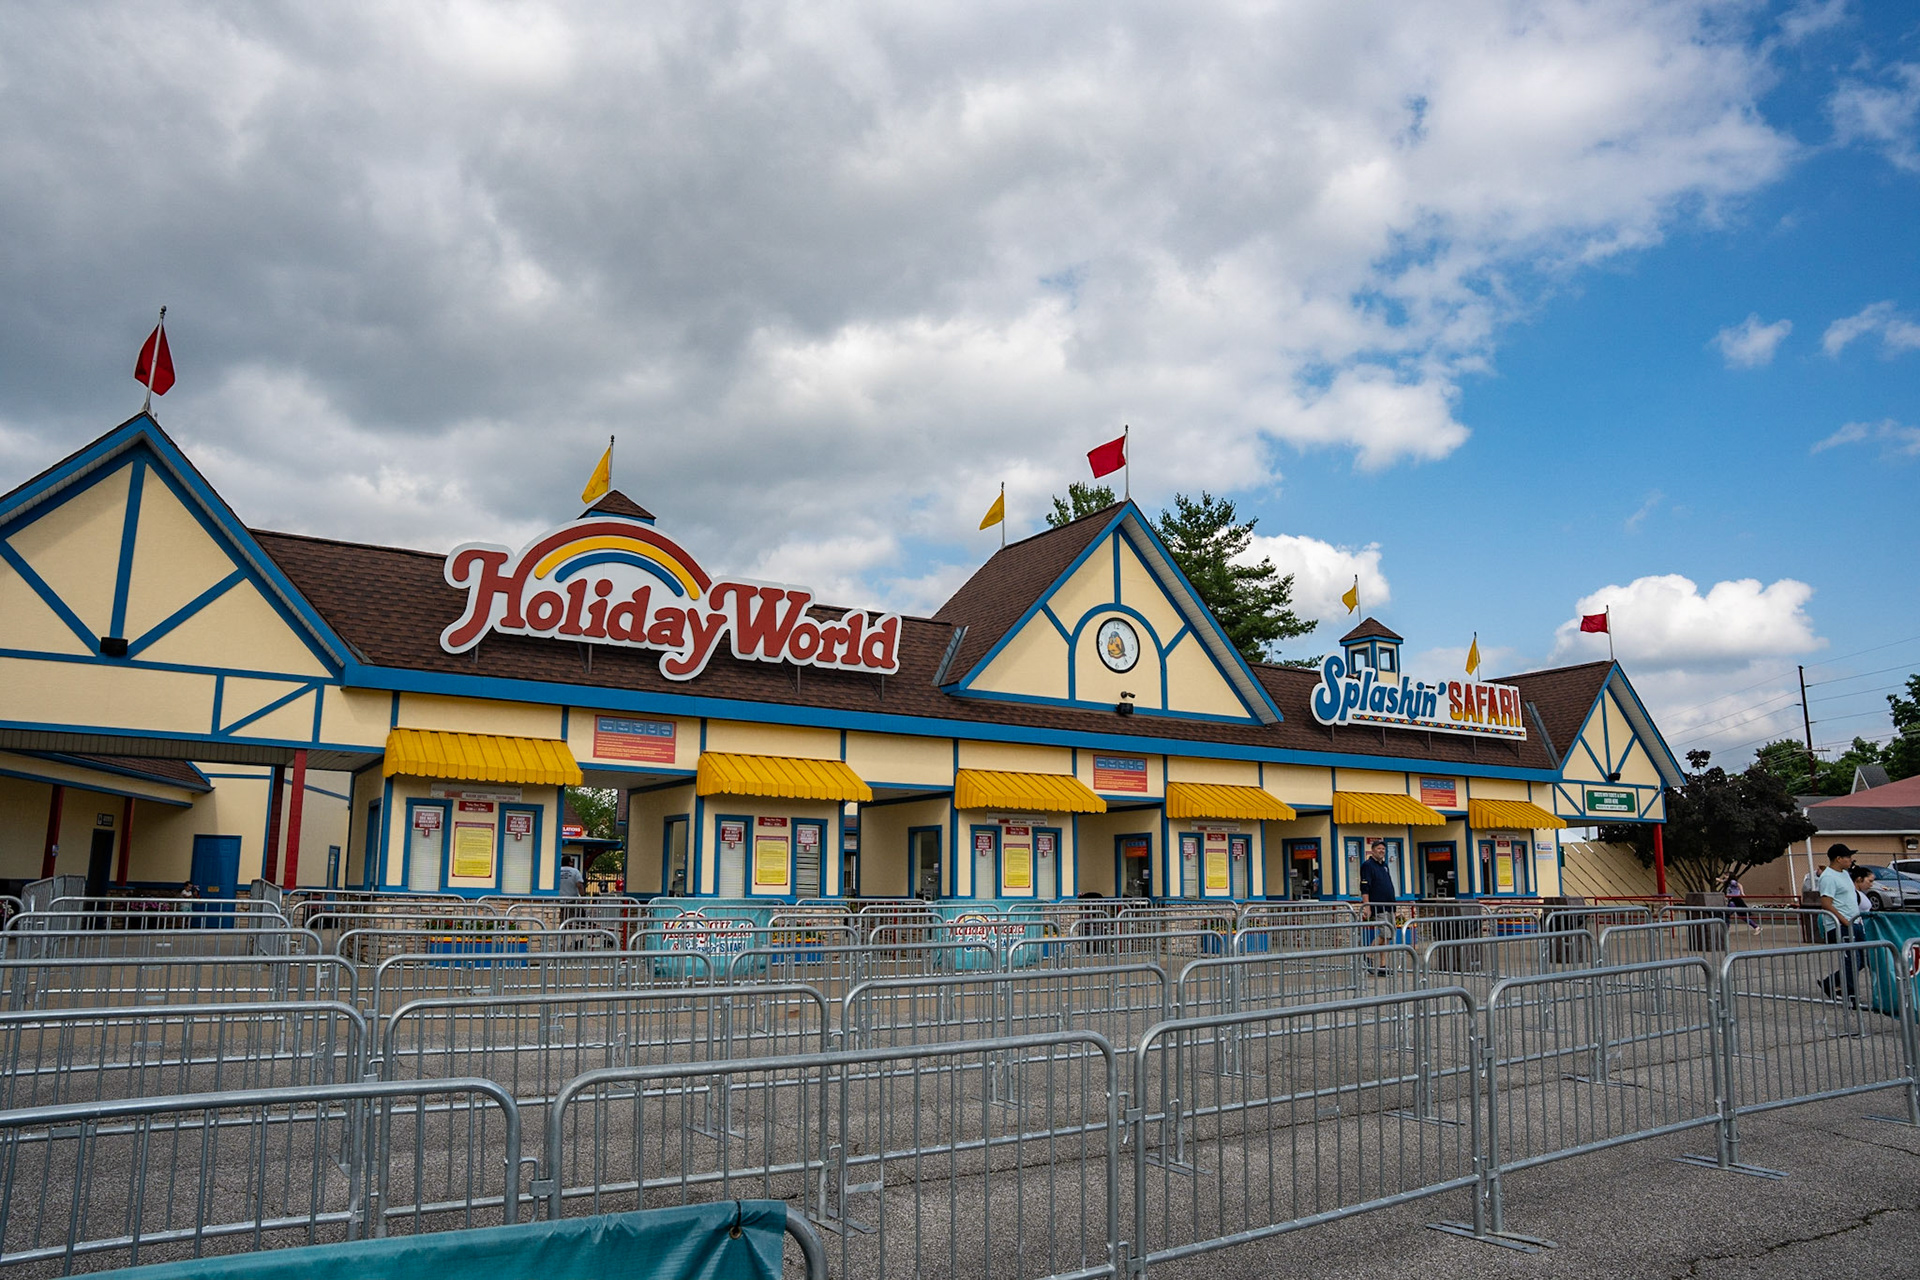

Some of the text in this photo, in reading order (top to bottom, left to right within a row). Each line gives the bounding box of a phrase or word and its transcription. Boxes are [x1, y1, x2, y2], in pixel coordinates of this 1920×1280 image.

[447, 536, 897, 675] Holiday World
[1113, 622, 1120, 630] 12
[1315, 655, 1521, 728] Splashin' SAFARI
